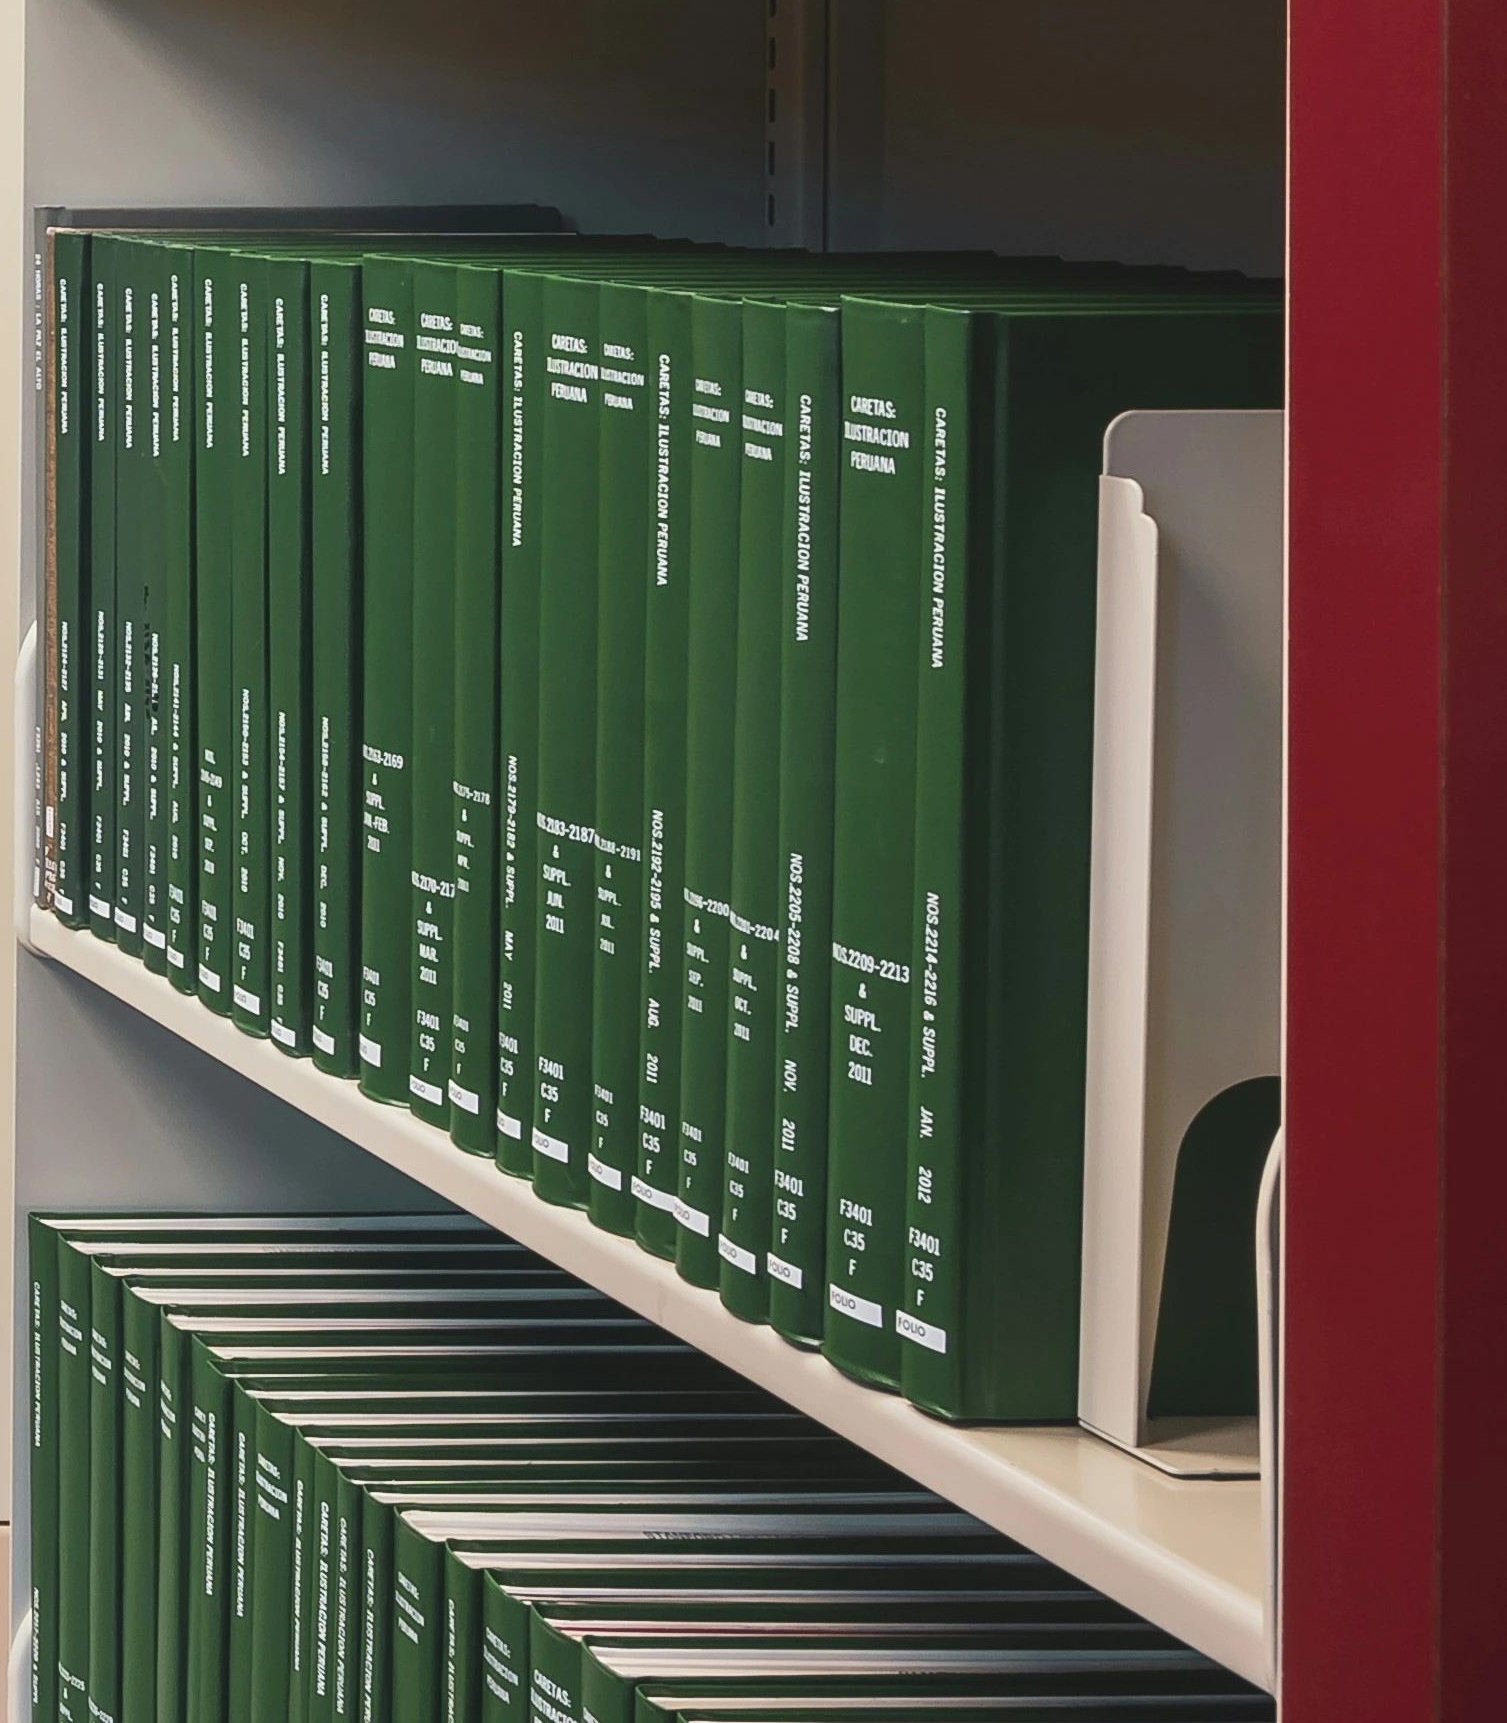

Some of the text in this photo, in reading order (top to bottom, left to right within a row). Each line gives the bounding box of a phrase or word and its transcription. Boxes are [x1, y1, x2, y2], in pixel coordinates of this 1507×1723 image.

[851, 452, 896, 475] PERUANA
[656, 522, 668, 587] PERUANA
[932, 598, 944, 669] PERUANA
[844, 1005, 880, 1032] SUPPL.
[922, 1012, 935, 1020] &
[849, 1035, 873, 1057] DEC.
[920, 1026, 936, 1078] SUPPL.
[848, 1062, 872, 1085] 2011
[920, 1107, 933, 1138] JAN.
[918, 1165, 932, 1204] 2012
